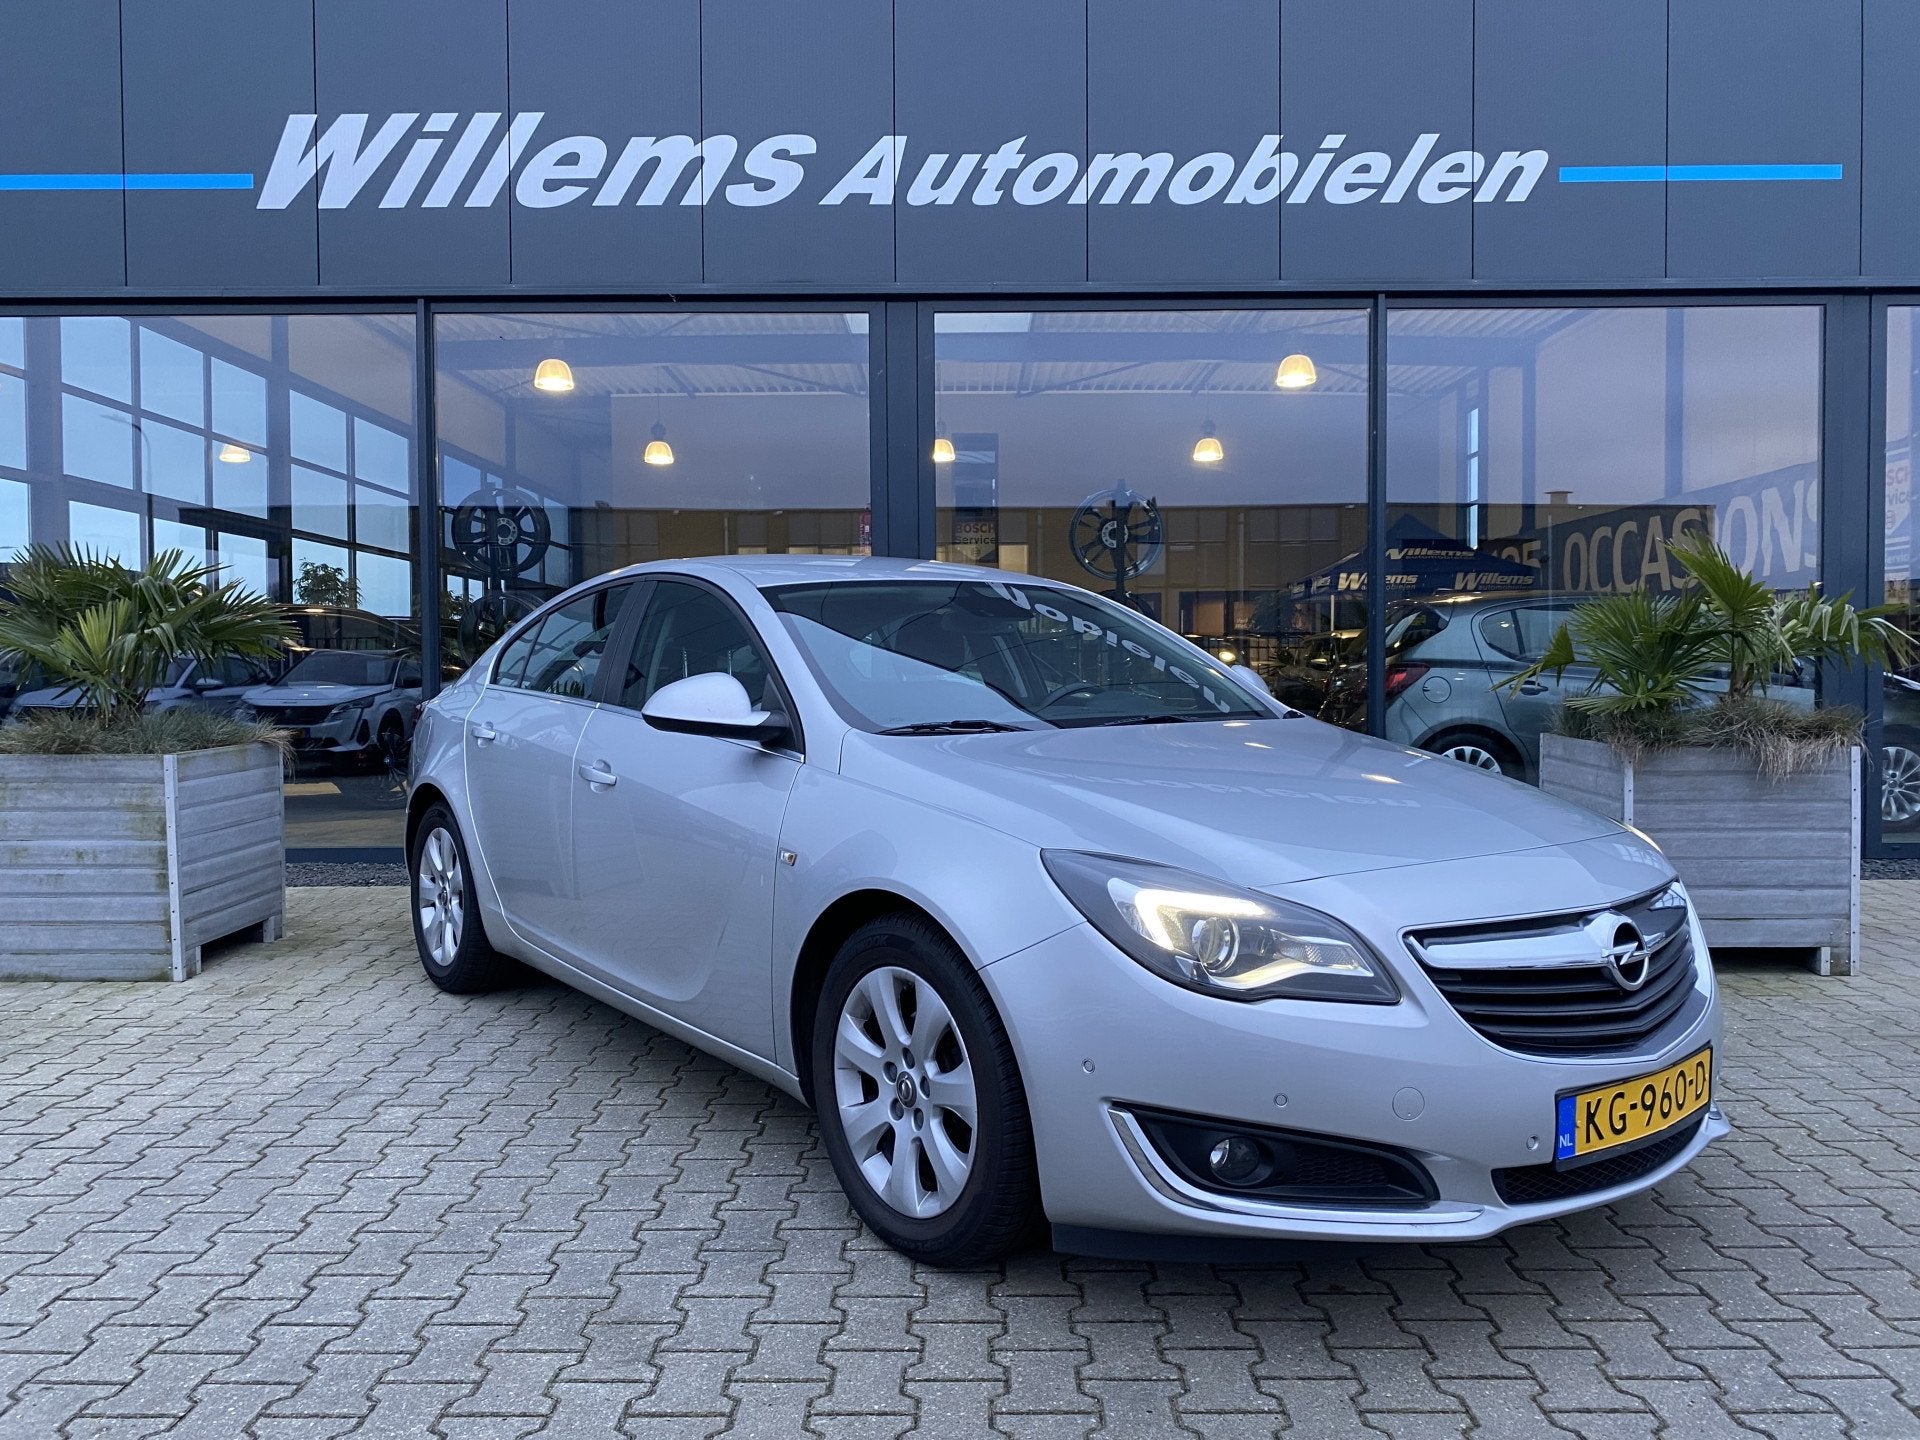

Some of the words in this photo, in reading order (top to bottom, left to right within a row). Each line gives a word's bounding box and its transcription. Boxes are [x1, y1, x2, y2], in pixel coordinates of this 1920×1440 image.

[256, 111, 817, 209] Willems
[819, 133, 1549, 206] Automobielen
[1455, 572, 1535, 590] Willems
[1585, 1060, 1707, 1144] KG-960-D
[1559, 1133, 1573, 1148] NL
